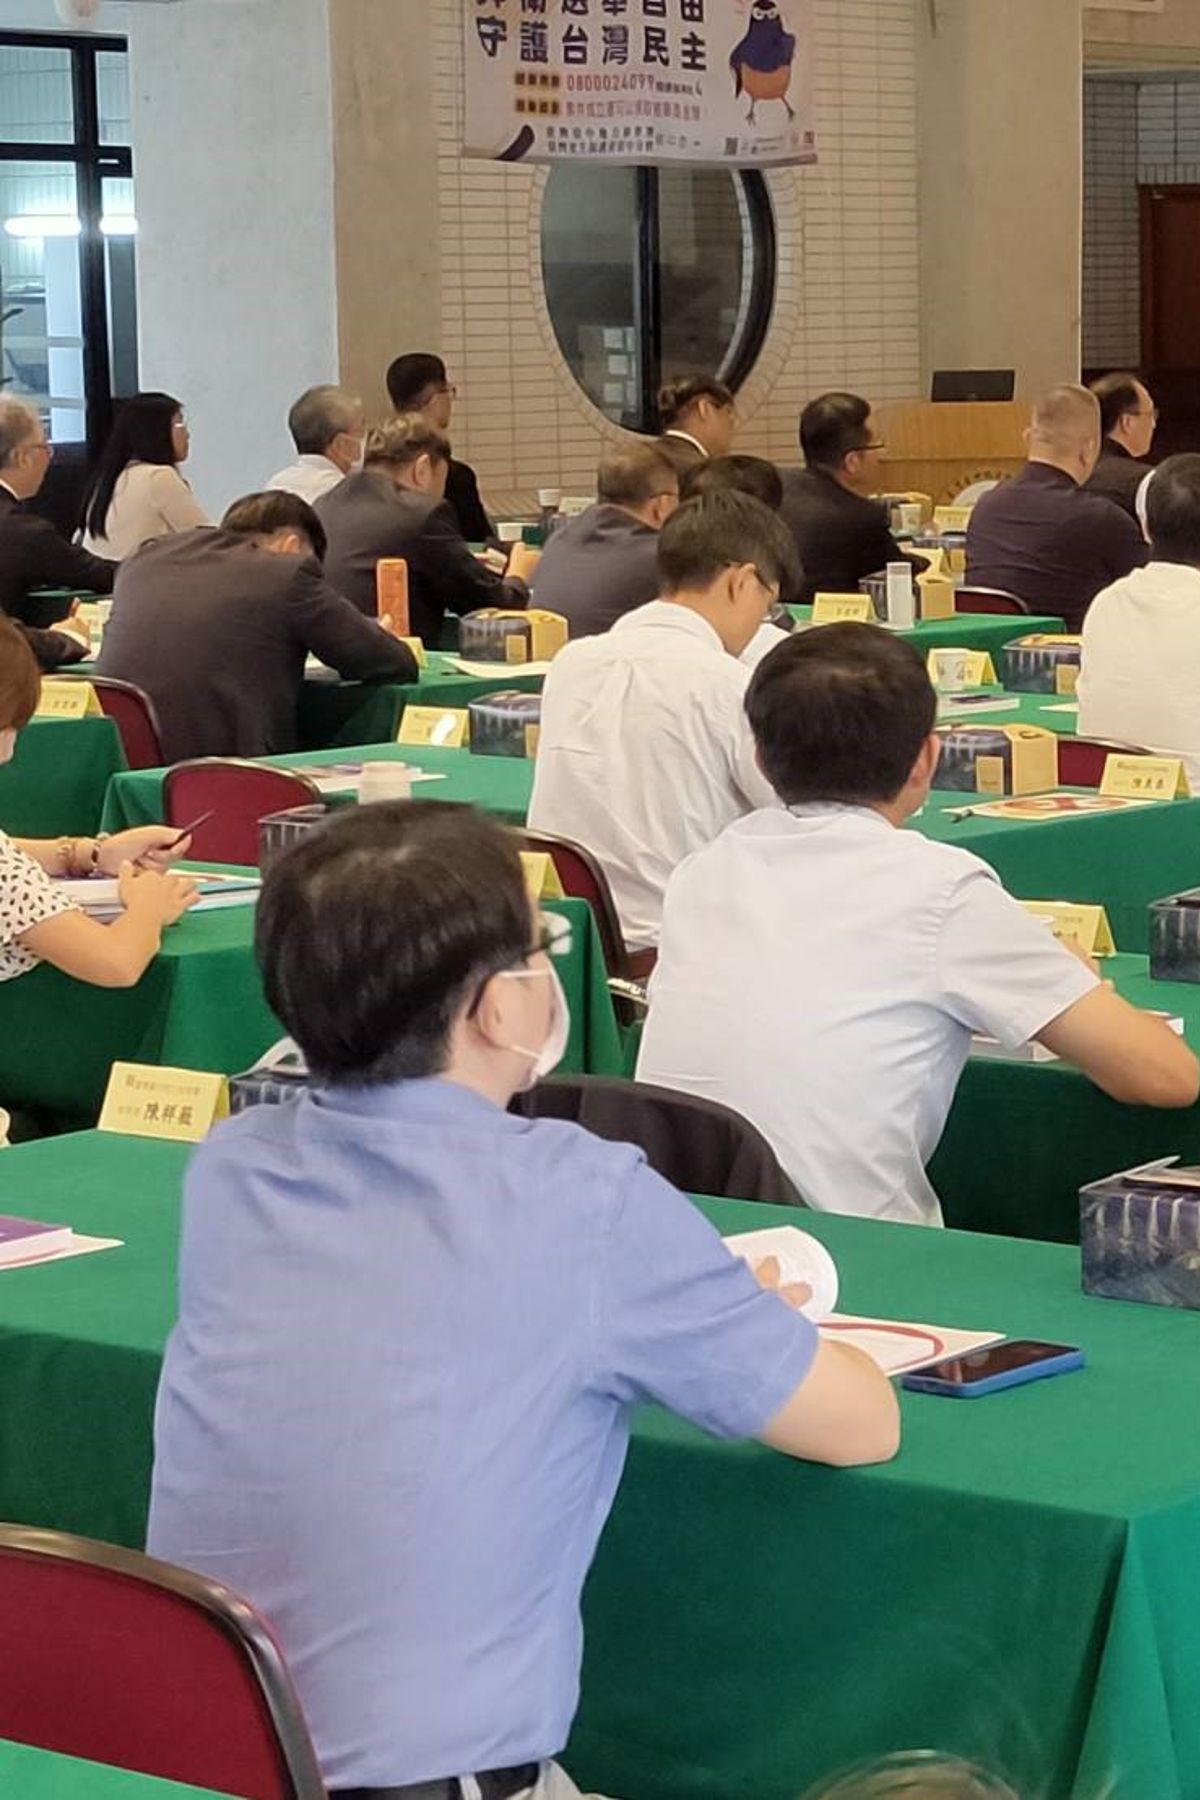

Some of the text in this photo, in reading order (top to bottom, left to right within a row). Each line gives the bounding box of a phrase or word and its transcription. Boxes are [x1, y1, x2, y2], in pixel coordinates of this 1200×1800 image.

[476, 16, 706, 71] 守護台灣民主
[566, 74, 654, 91] 0800024099
